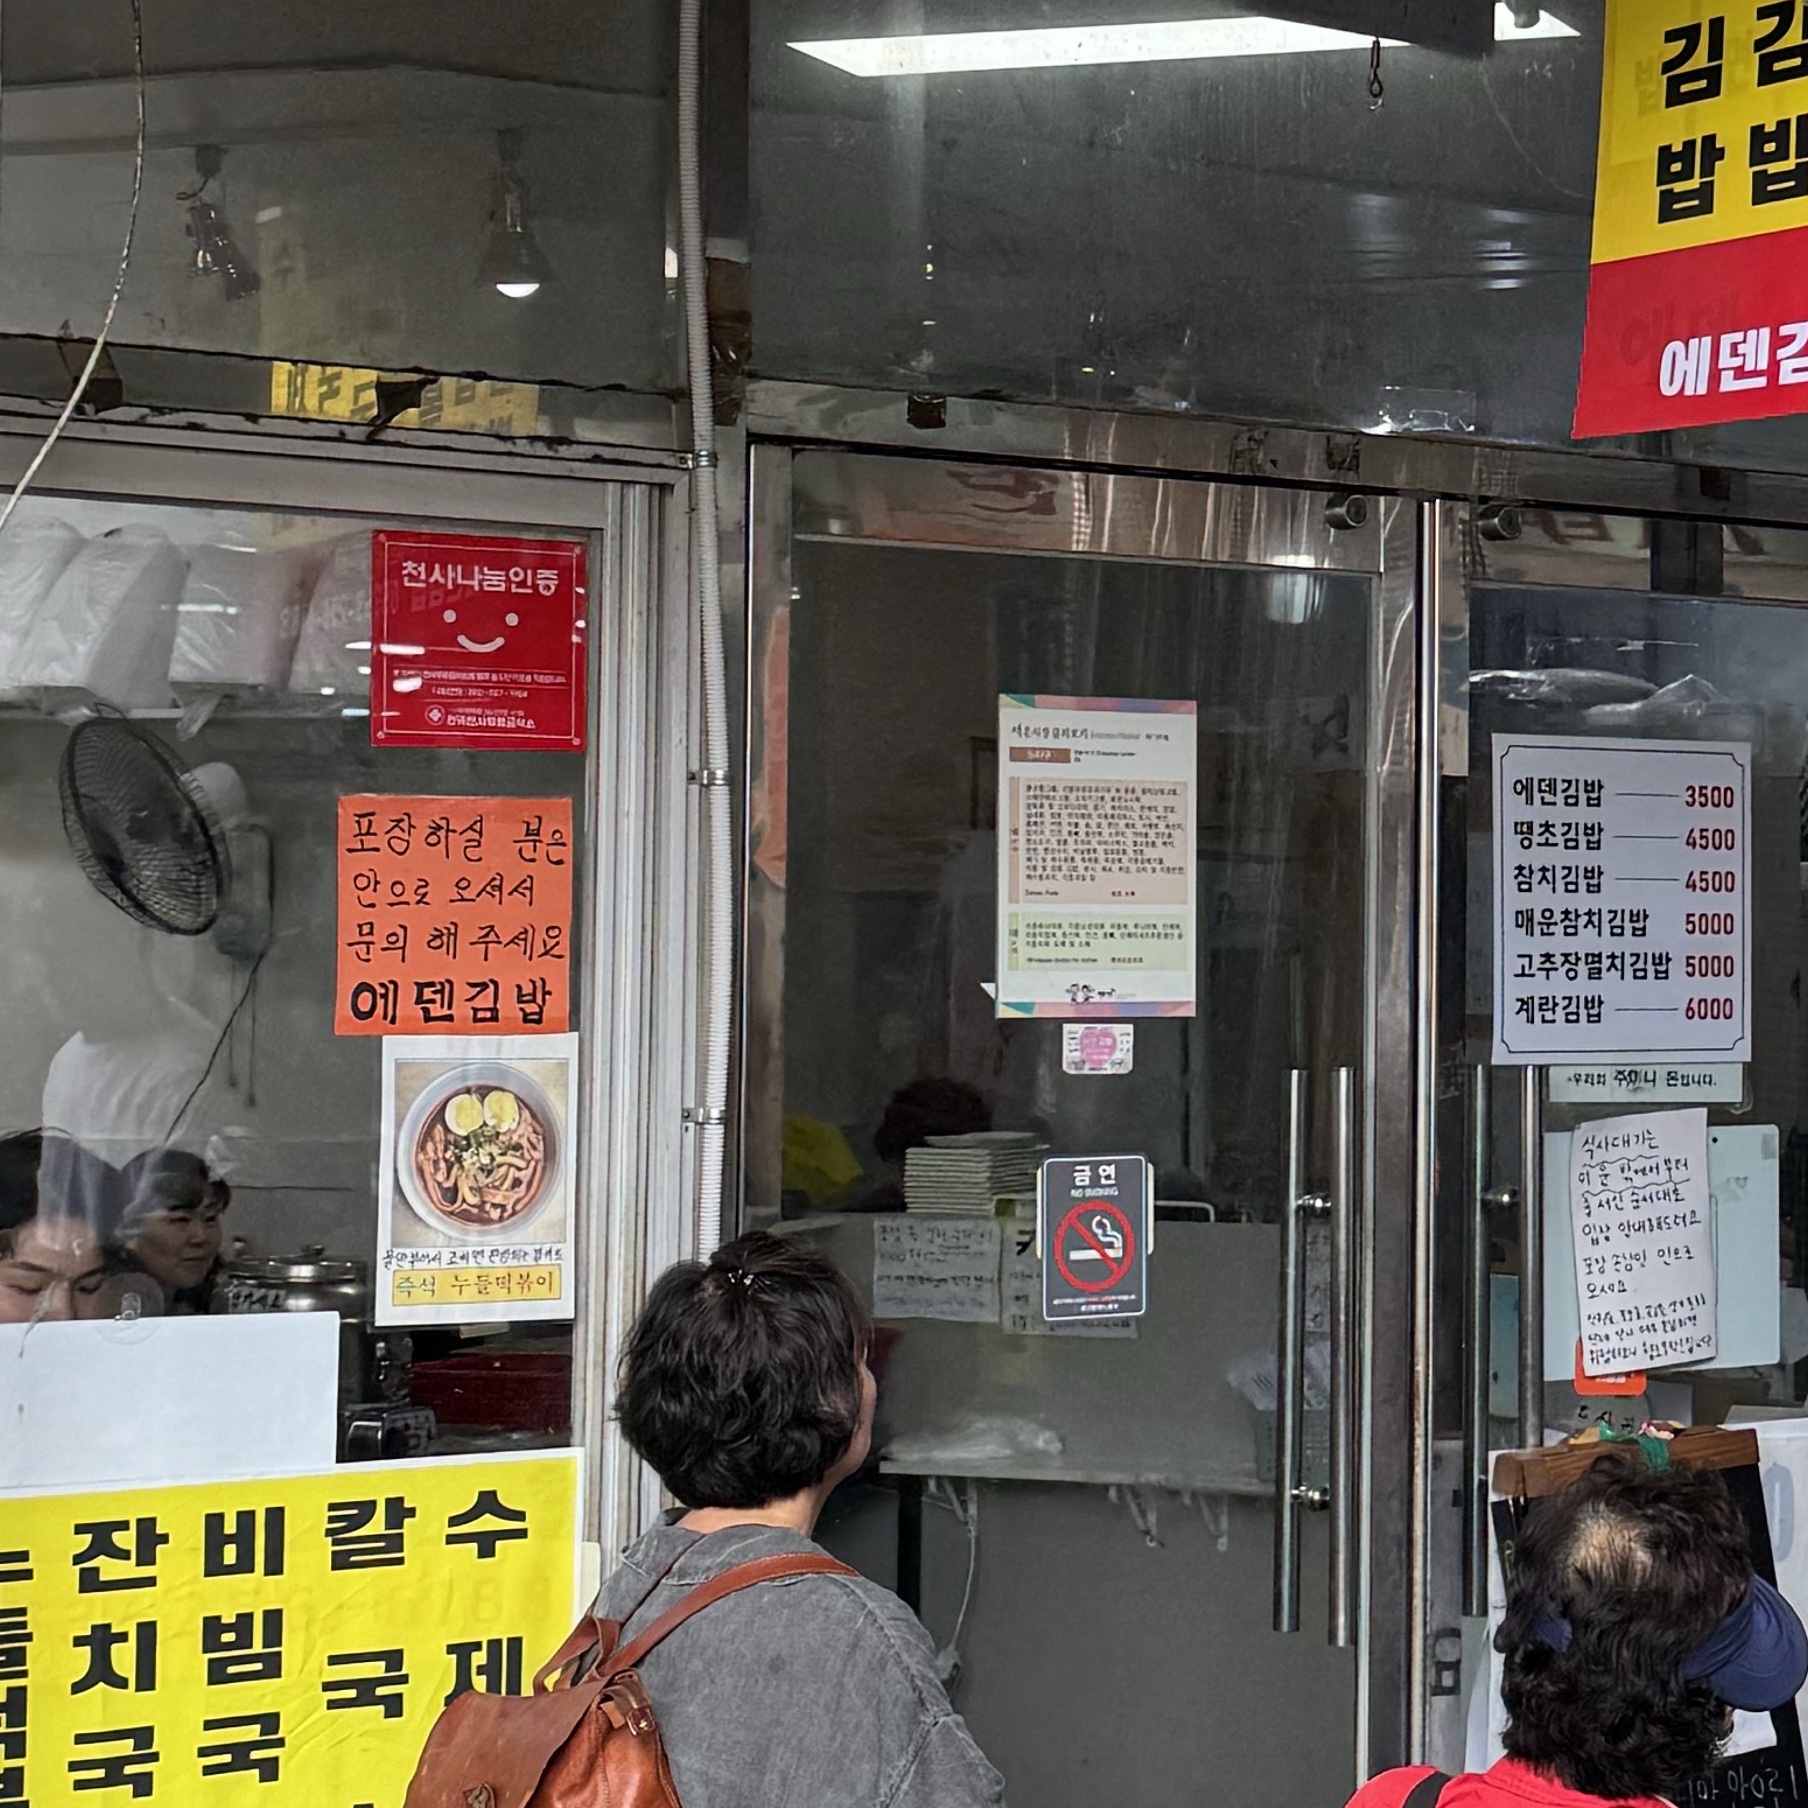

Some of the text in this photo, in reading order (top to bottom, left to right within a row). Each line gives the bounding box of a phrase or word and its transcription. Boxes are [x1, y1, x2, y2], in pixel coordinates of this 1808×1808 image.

[402, 560, 559, 597] 천사나눔인증
[1513, 777, 1734, 809] 에덴김밥 3500
[345, 811, 568, 866] 포장하실 분은
[1513, 820, 1736, 851] 땡초김밥 4500
[352, 867, 534, 909] 안으로 오셔서
[1513, 864, 1736, 895] 참치김밥 4500
[1515, 907, 1734, 938] 매운참치김밥 5000
[346, 921, 566, 963] 문의 해 주세요
[1513, 951, 1734, 981] 고추장멸치김밥 5000
[350, 976, 552, 1026] 에덴김밥
[1515, 995, 1733, 1025] 계란김밥 6000
[1073, 1164, 1116, 1186] 금연
